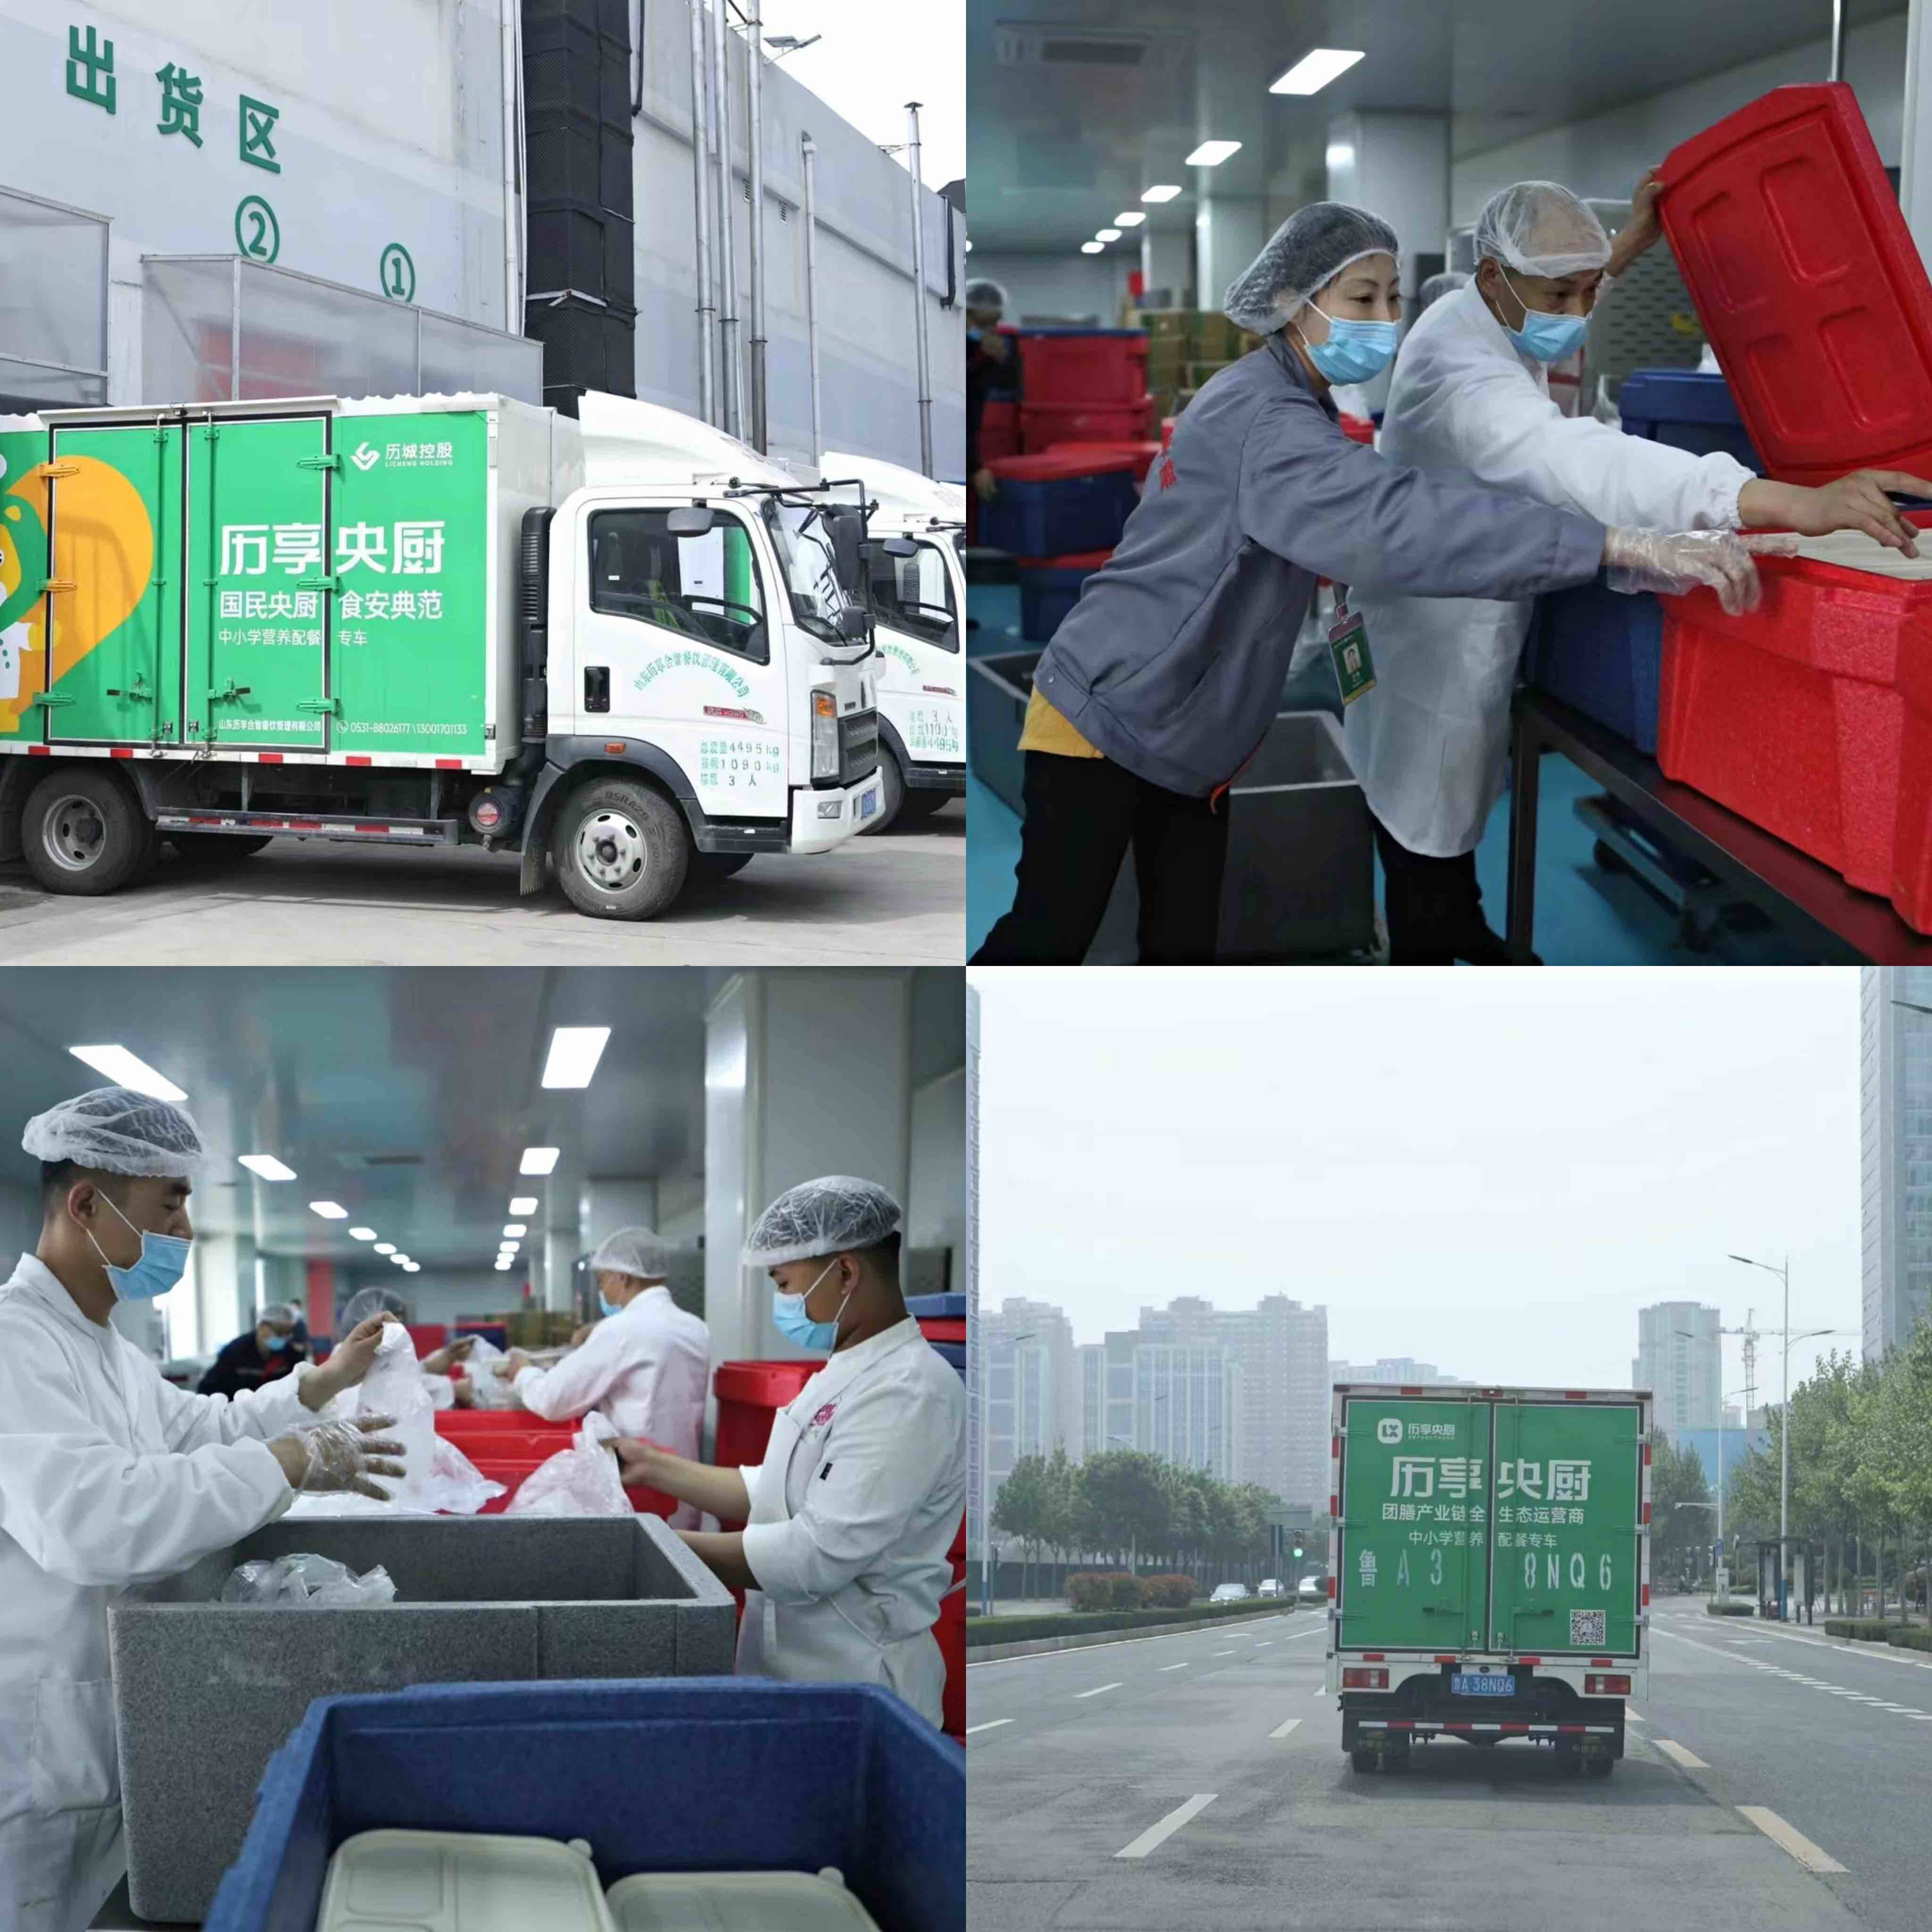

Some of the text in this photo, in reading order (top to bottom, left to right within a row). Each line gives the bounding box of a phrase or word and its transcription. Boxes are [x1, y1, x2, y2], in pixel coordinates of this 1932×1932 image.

[67, 25, 281, 174] 出货区
[386, 442, 453, 460] 历城控股
[219, 521, 445, 575] 历享央厨
[220, 590, 443, 620] 国民央厨 食安典范
[1390, 1456, 1592, 1501] 历享央厨
